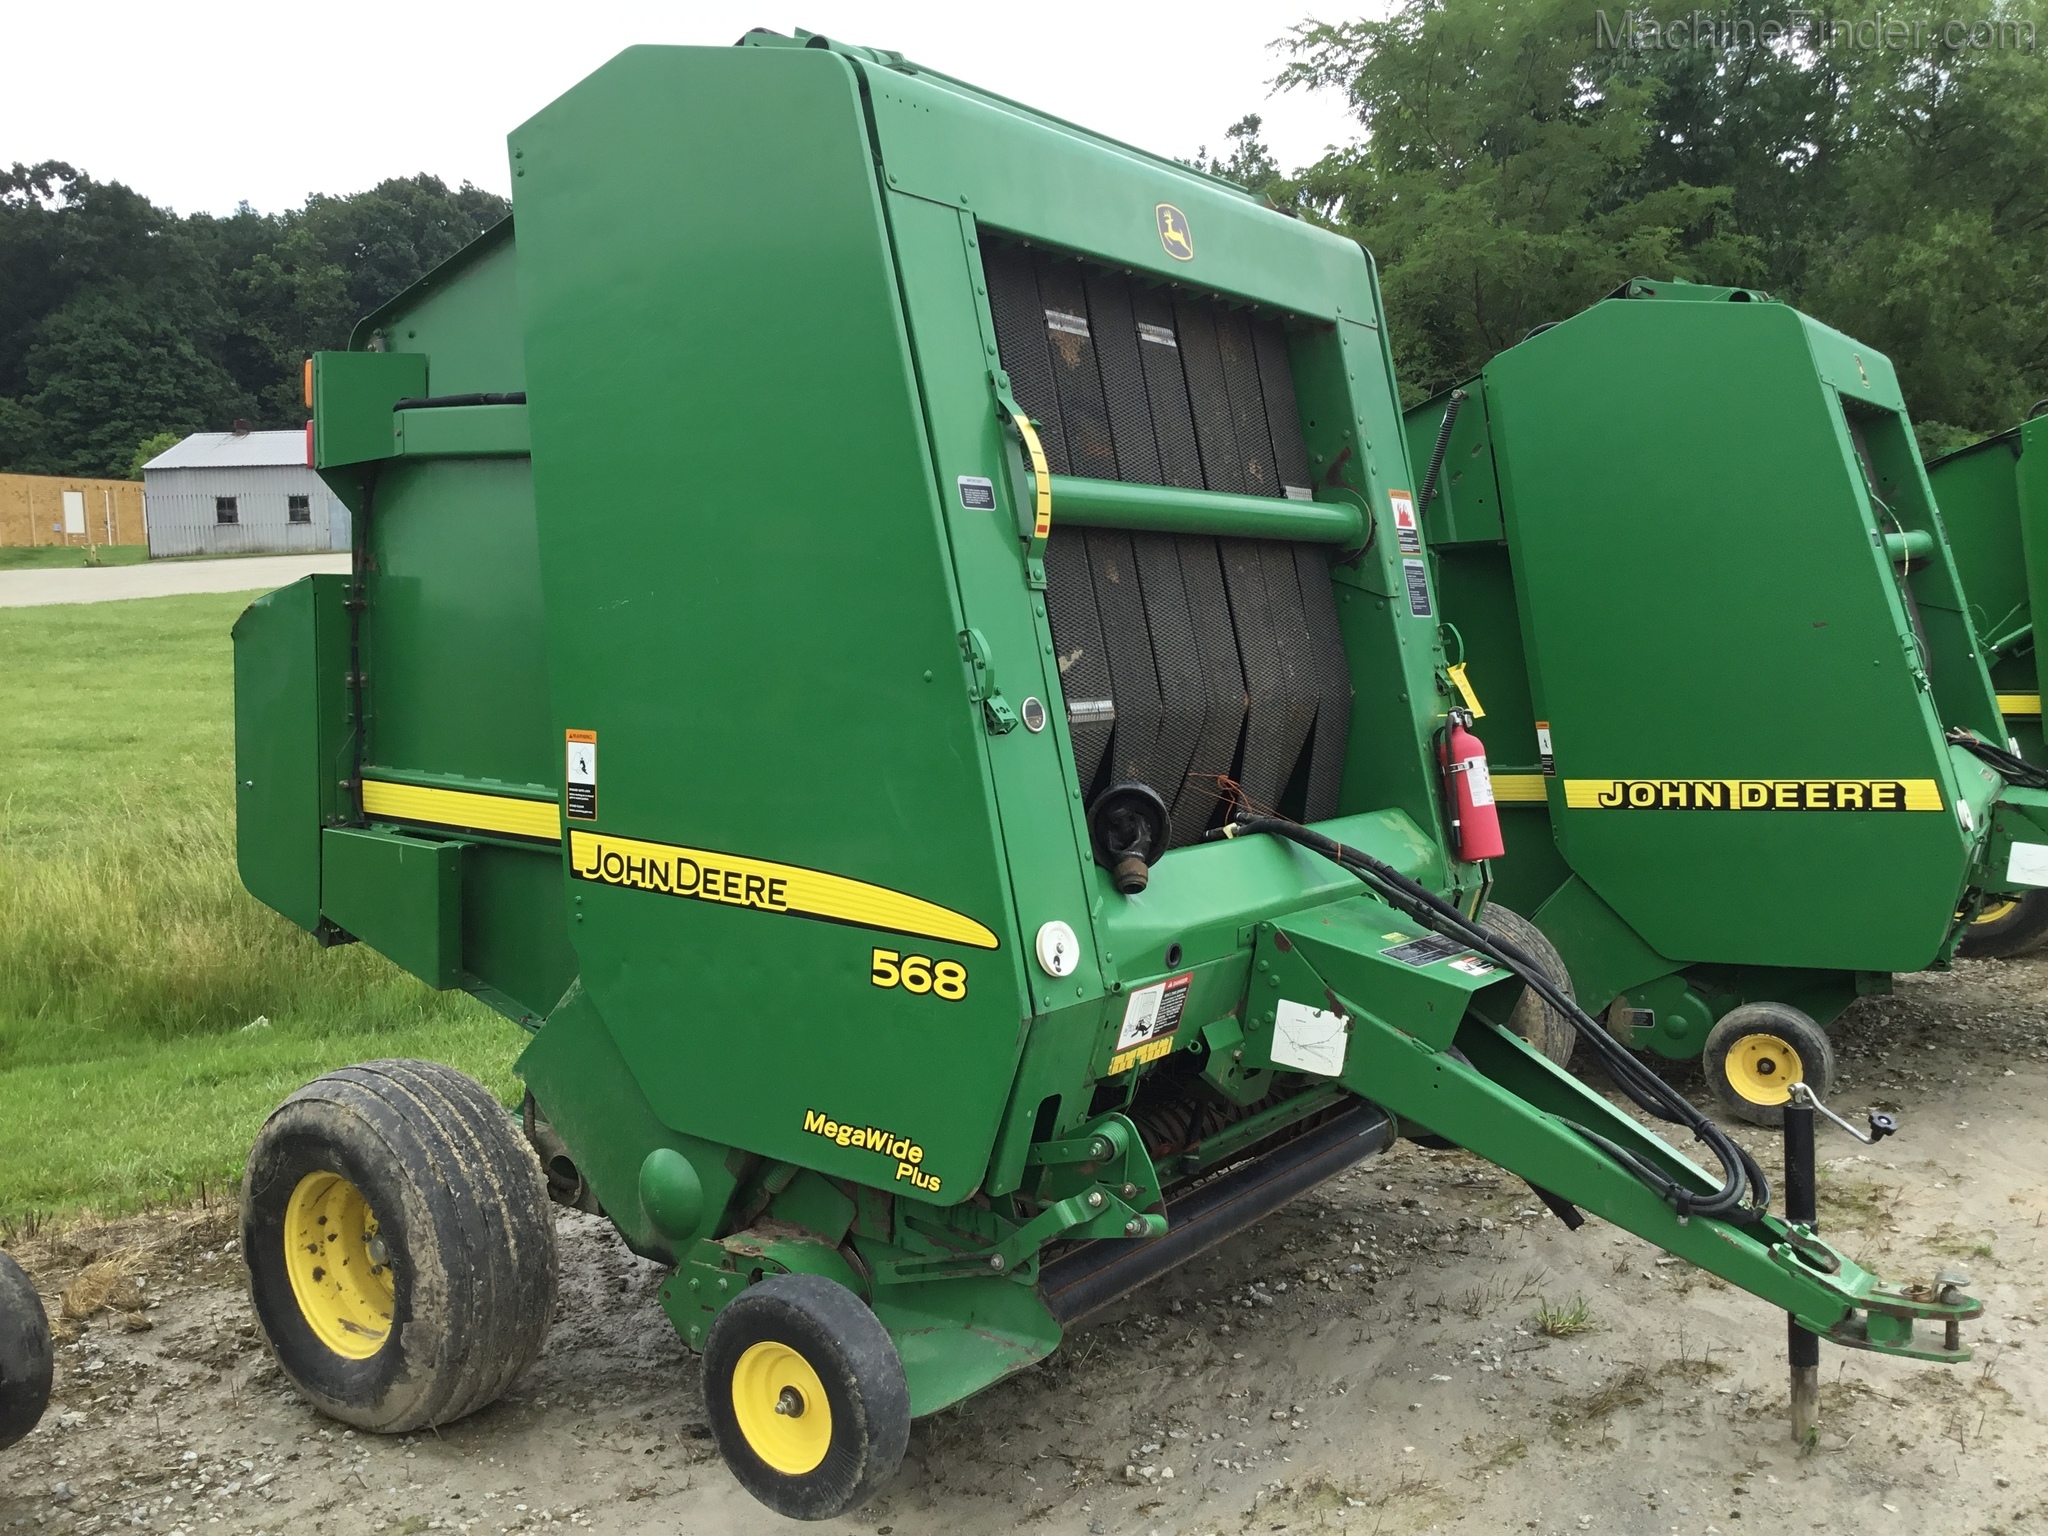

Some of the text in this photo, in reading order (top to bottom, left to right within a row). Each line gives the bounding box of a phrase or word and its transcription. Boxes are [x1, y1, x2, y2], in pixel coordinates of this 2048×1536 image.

[1599, 782, 1900, 809] JOHN DEERE
[585, 844, 788, 908] JOHN DEERE
[872, 947, 967, 1000] 568
[802, 1109, 924, 1164] MegaWide
[895, 1161, 942, 1192] Plus
